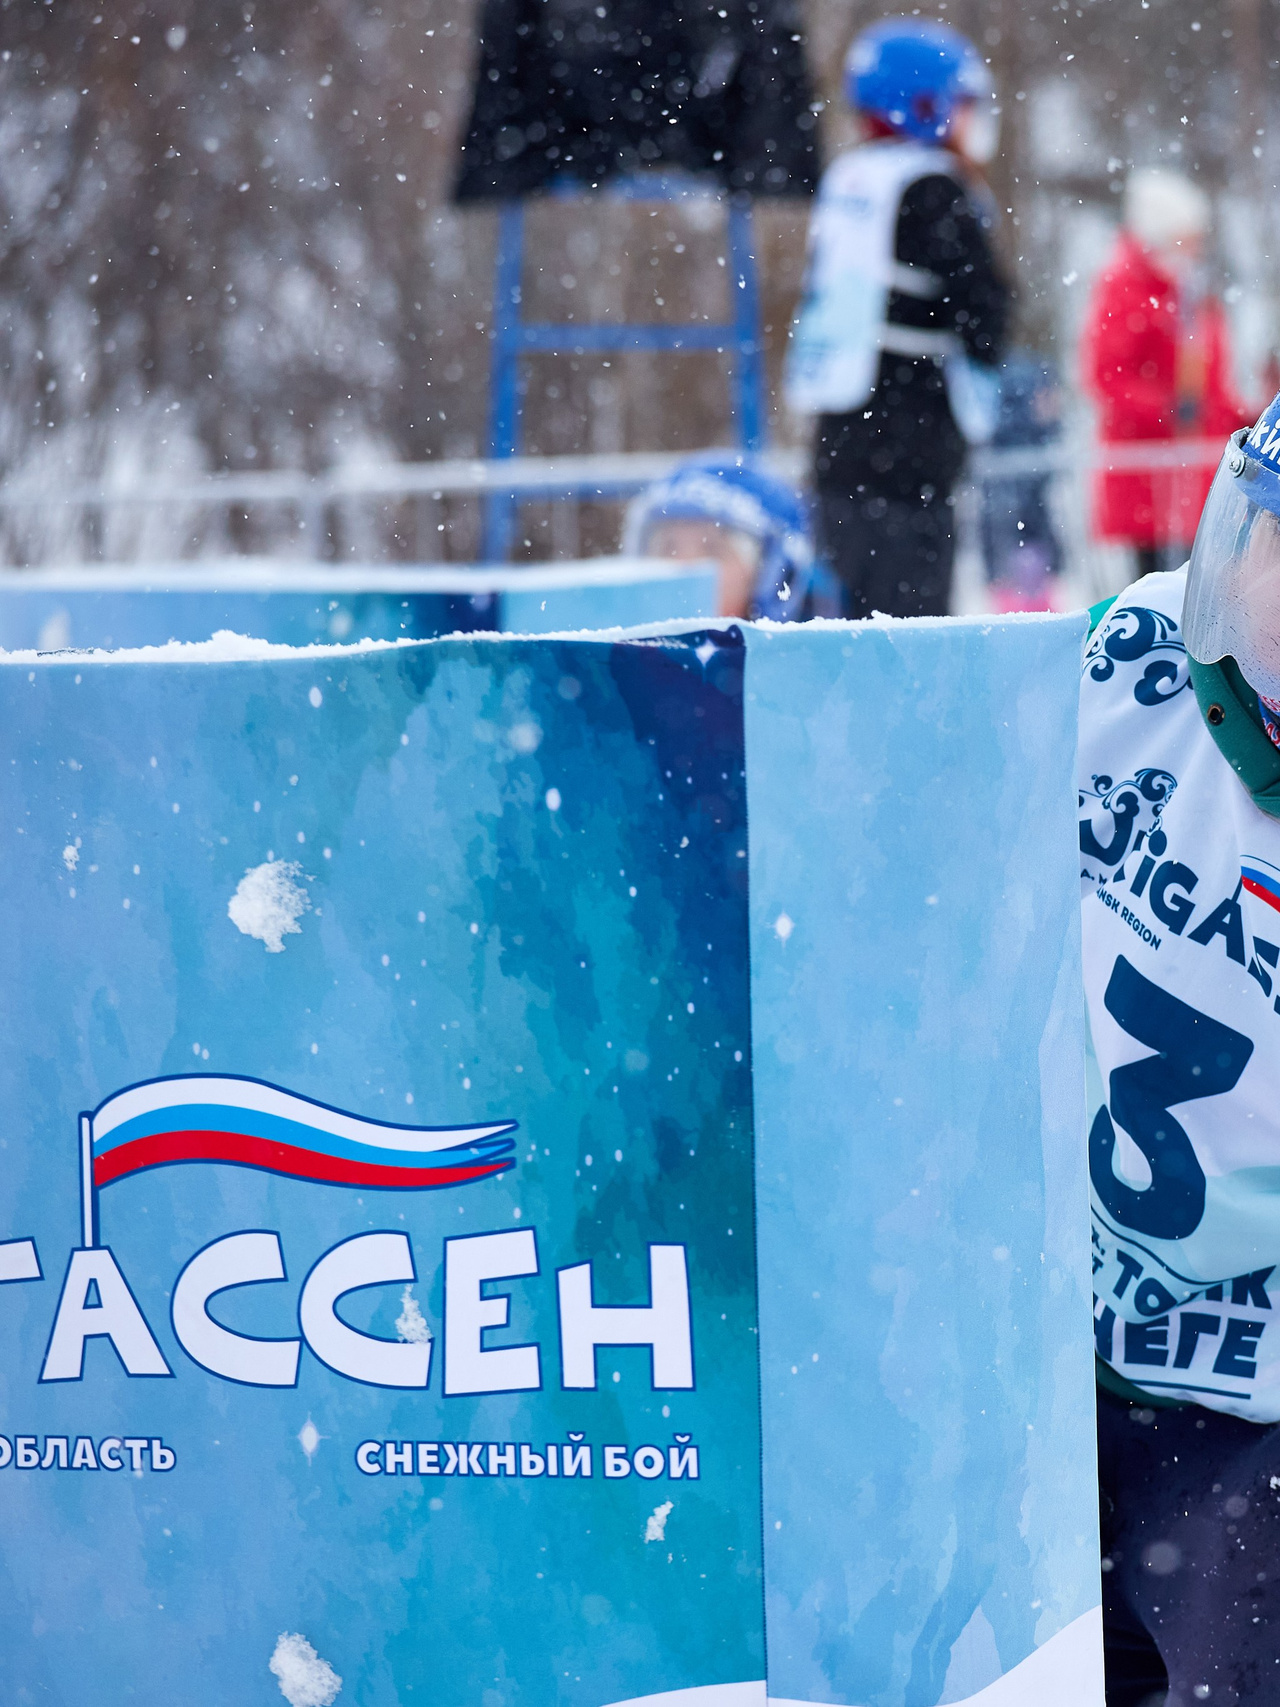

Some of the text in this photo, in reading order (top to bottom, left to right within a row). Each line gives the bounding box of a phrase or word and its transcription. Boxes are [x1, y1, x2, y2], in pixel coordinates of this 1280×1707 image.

[1120, 906, 1162, 951] REGION
[1088, 953, 1255, 1241] 3
[355, 1431, 701, 1481] СНЕЖНЫЙ БОЙ
